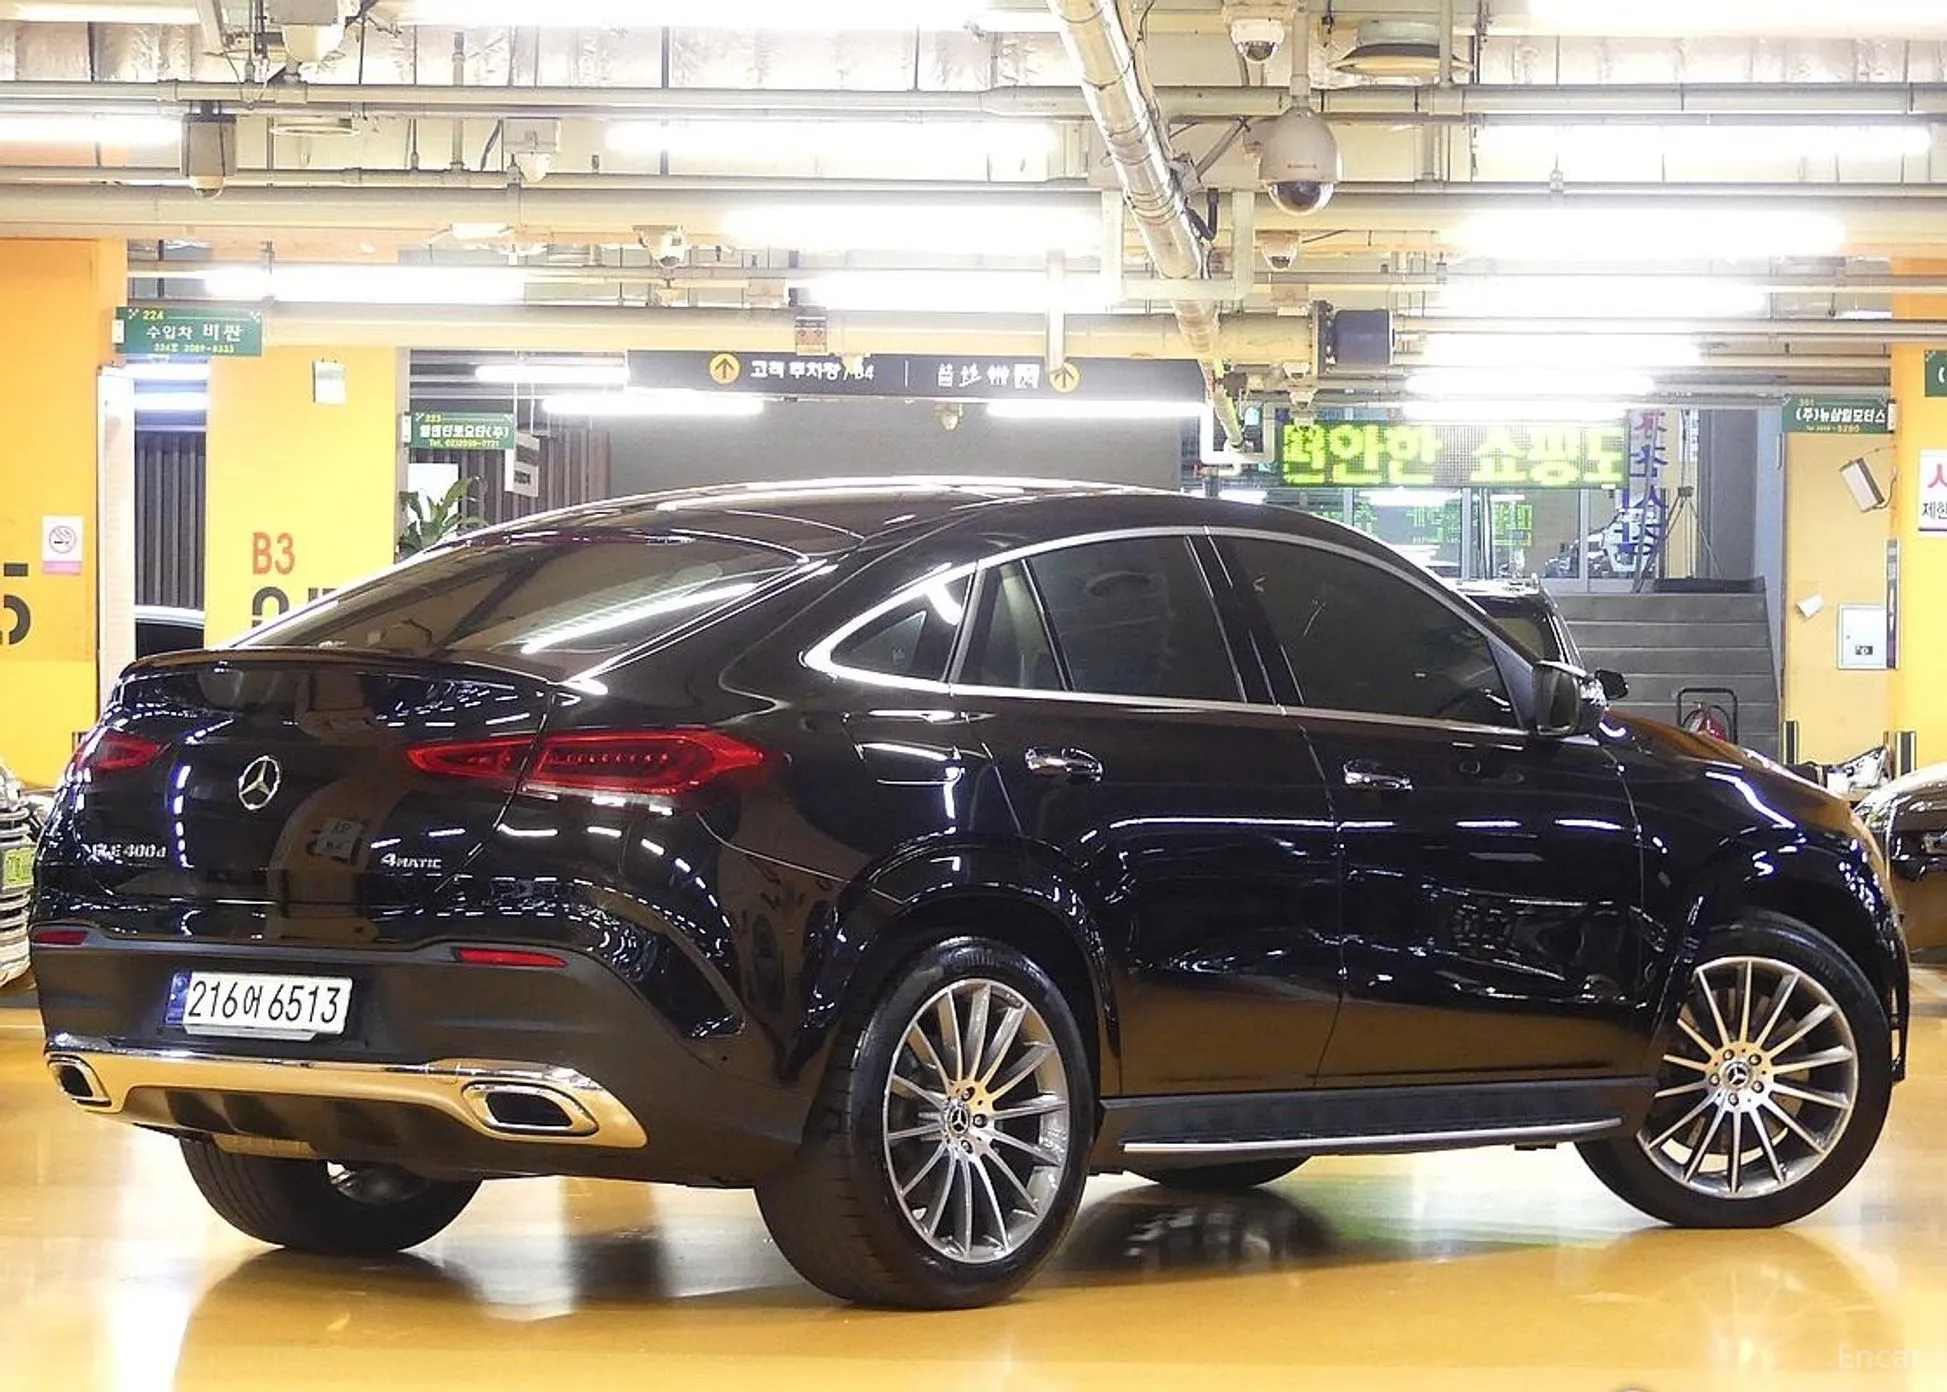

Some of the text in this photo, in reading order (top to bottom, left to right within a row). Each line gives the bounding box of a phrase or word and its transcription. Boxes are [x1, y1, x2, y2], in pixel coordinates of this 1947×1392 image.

[142, 309, 164, 321] 224
[146, 325, 193, 340] 수입차
[252, 531, 296, 576] B3
[122, 843, 167, 858] 400d
[381, 852, 442, 869] 4MATIC
